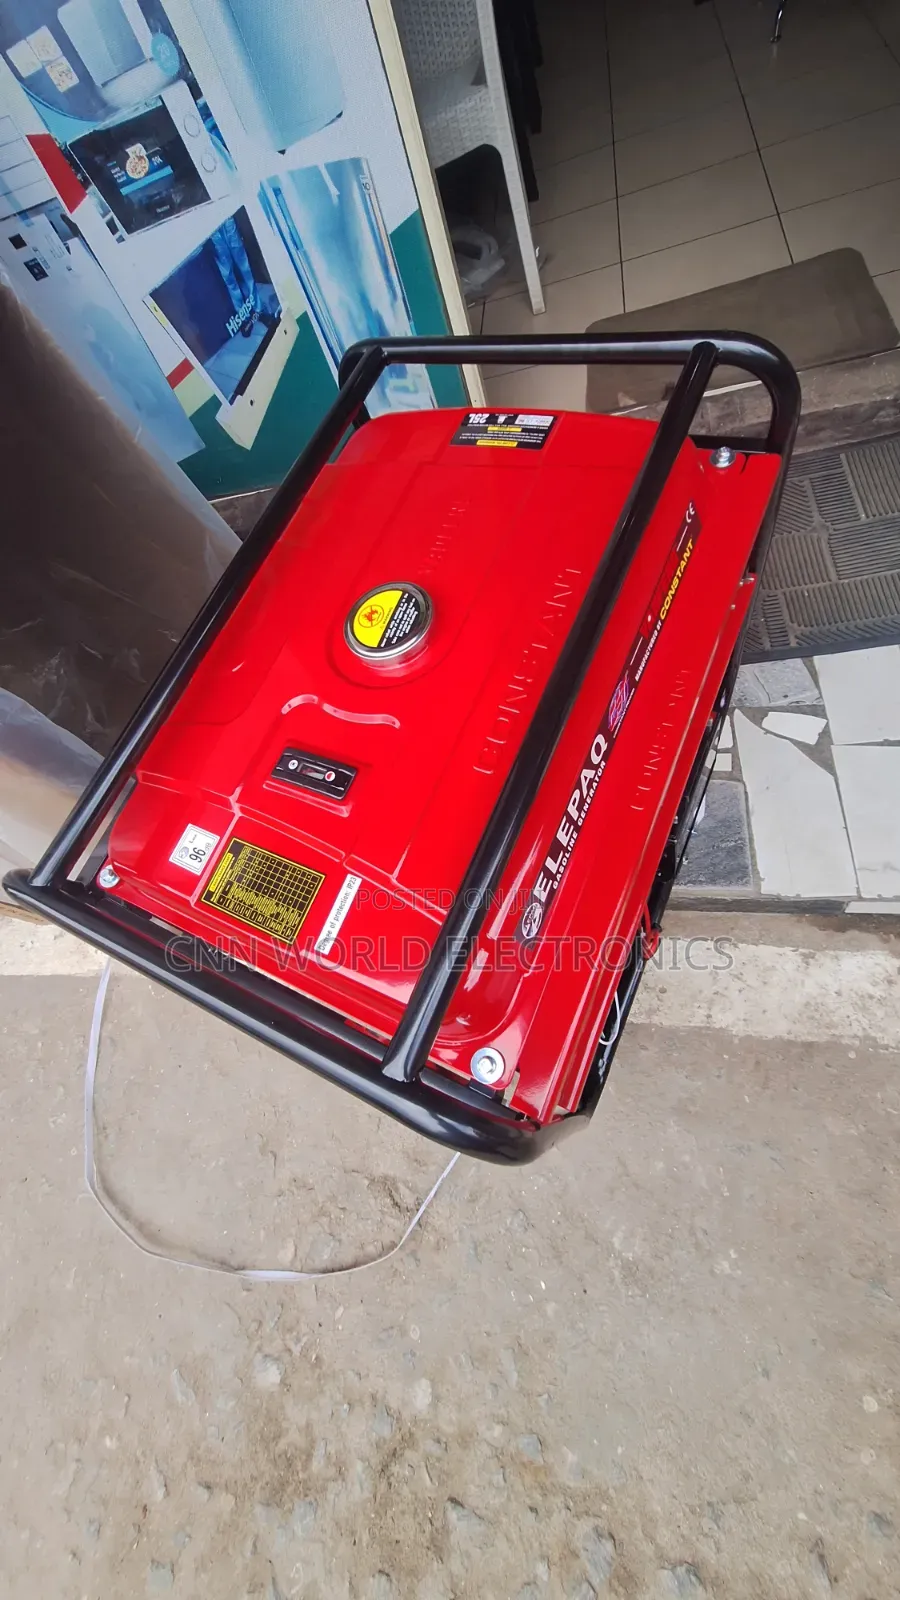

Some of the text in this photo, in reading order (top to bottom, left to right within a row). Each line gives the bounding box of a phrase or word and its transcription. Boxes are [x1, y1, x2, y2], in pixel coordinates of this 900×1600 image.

[226, 294, 256, 338] Hisense
[468, 412, 490, 424] 25L
[685, 502, 696, 524] CE
[635, 630, 658, 682] MANUFACTURED
[660, 538, 694, 620] CONSTANT
[534, 734, 608, 902] ELEPAQ
[553, 761, 606, 890] GASOLINE GENERATOR
[189, 847, 206, 863] 96
